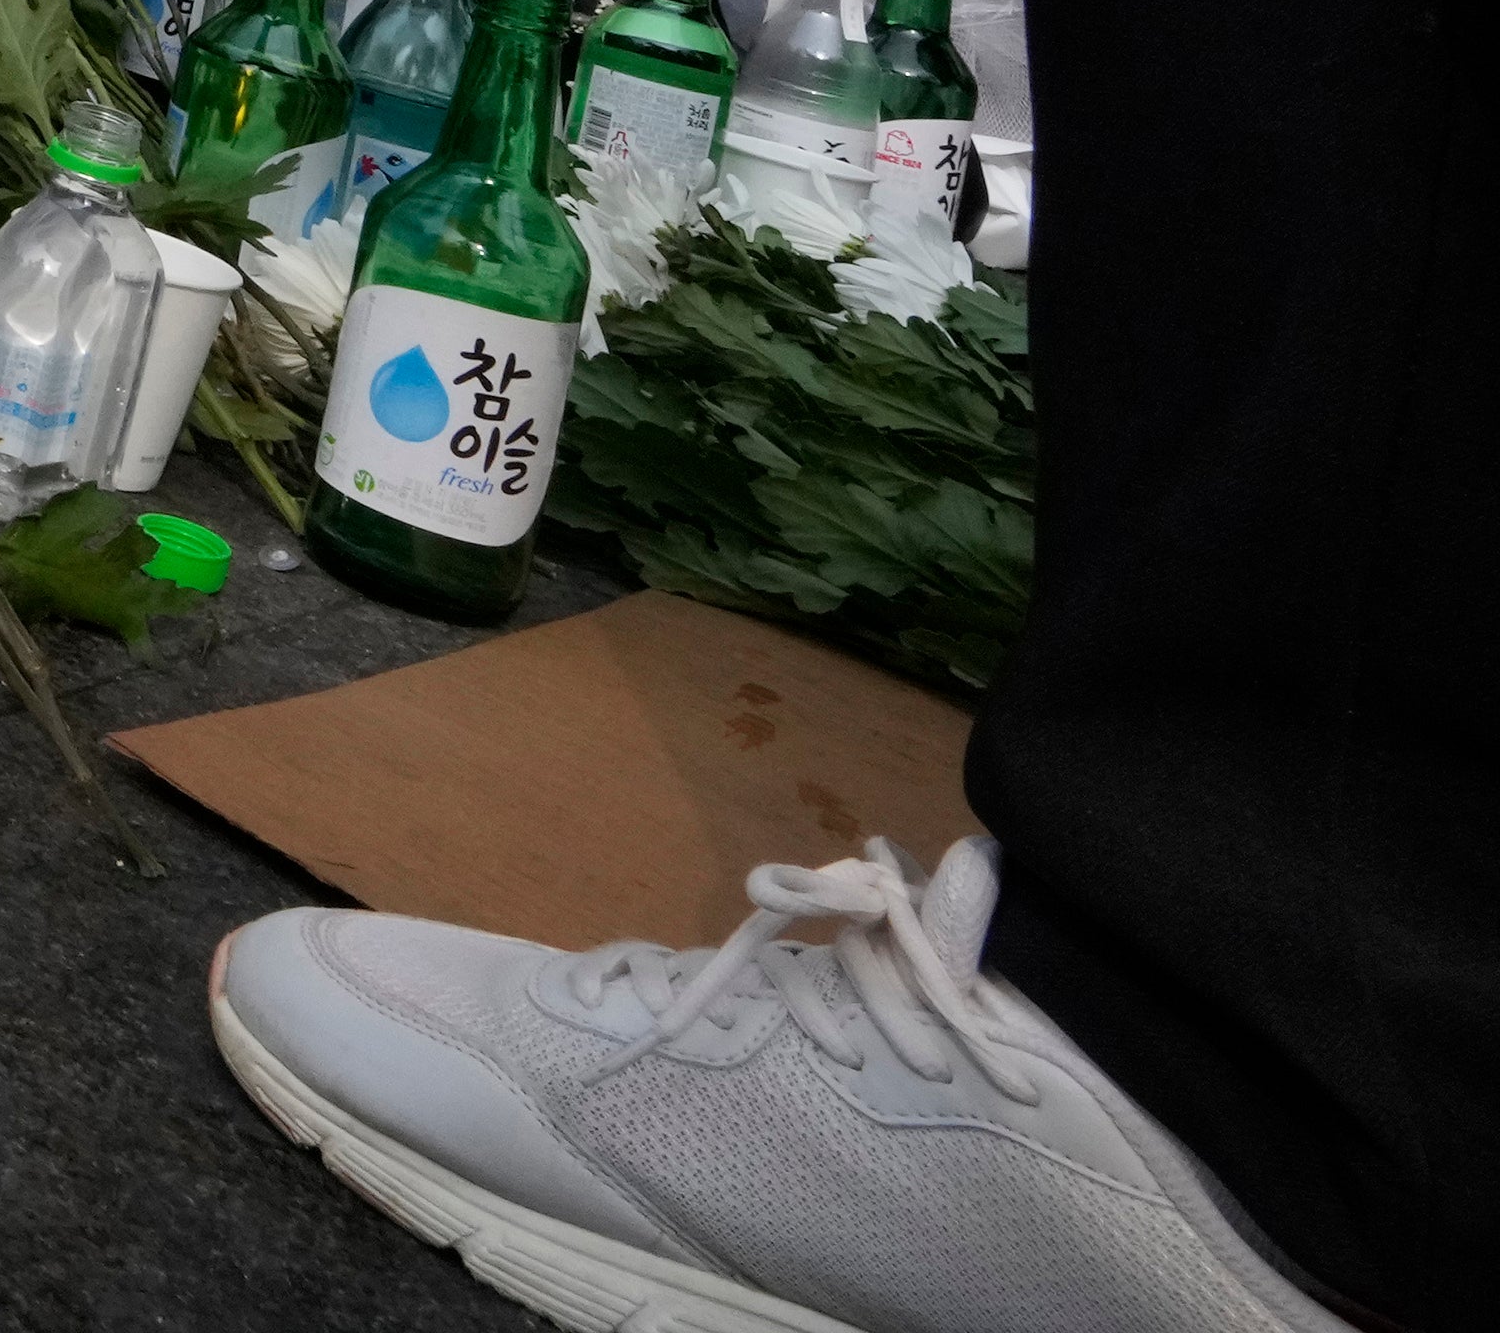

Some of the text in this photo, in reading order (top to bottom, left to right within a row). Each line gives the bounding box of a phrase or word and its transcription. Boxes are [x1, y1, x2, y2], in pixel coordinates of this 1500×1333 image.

[453, 337, 532, 422] 참
[437, 466, 495, 497] fresh
[449, 417, 540, 496] 이슬
